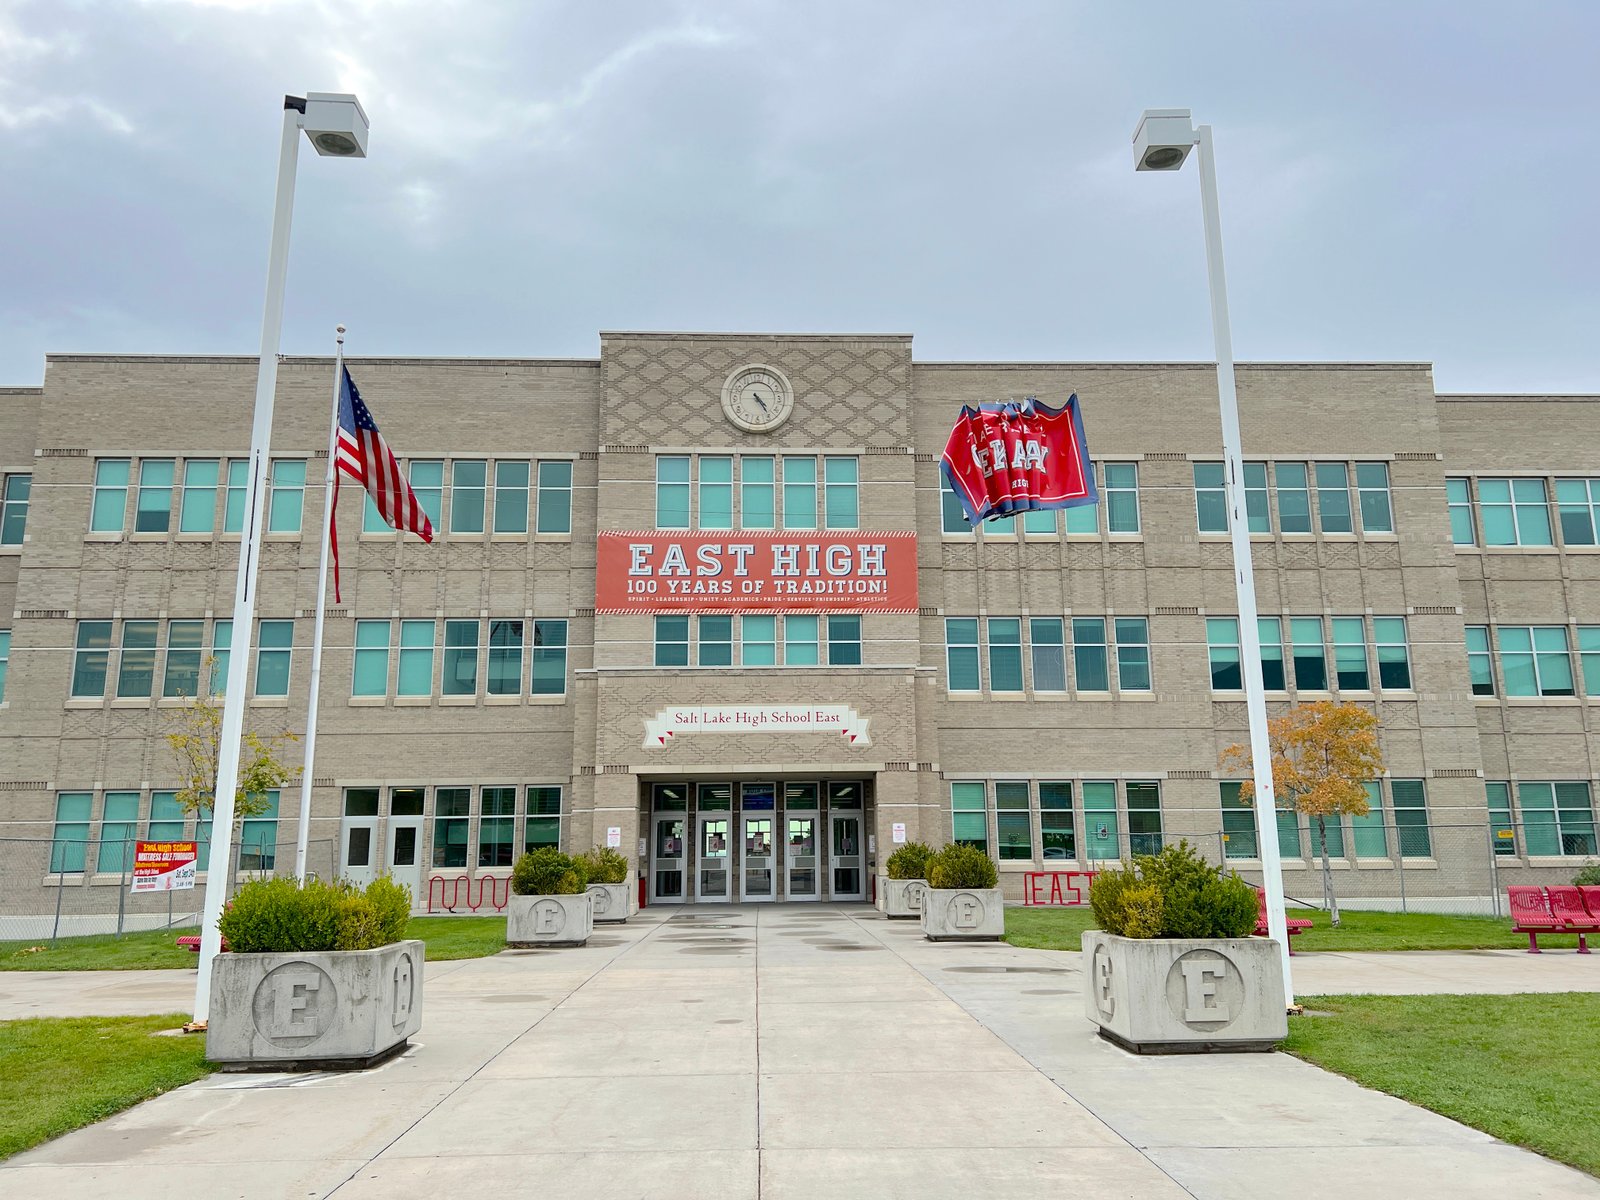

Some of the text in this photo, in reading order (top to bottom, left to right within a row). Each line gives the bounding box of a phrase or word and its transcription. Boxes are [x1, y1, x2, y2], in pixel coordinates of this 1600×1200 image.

[628, 543, 888, 577] EAST HIGH
[627, 579, 888, 594] 100 YEARS OF TRADITION!
[675, 711, 840, 727] Salt Lake High School East
[143, 843, 157, 852] East
[172, 843, 192, 852] School
[535, 903, 558, 934] E
[955, 899, 977, 928] E
[270, 972, 321, 1039] E
[1181, 959, 1230, 1023] E
